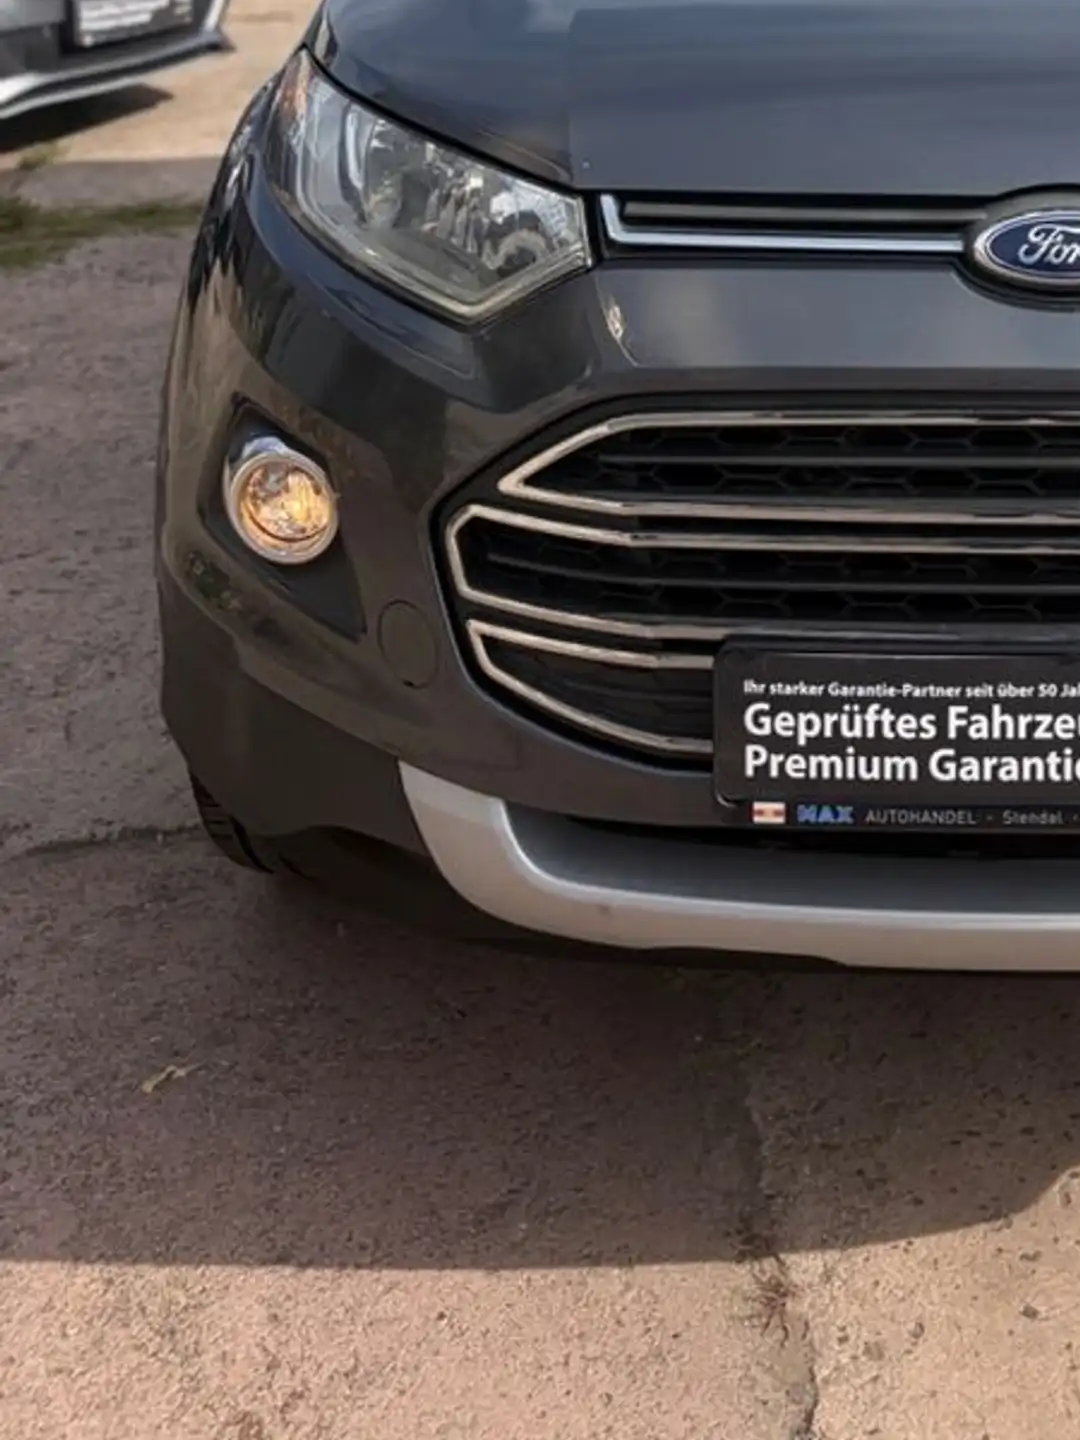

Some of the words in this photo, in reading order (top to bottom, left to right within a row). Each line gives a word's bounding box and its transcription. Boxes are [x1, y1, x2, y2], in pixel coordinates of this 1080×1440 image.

[743, 679, 765, 696] Ihr
[769, 681, 825, 697] starker
[827, 681, 962, 698] Garantie-Partner
[965, 682, 995, 698] seit
[997, 682, 1035, 698] über
[1037, 683, 1058, 698] 50
[744, 702, 938, 746] Geprüftes
[744, 744, 920, 781] Premium
[797, 804, 853, 824] MAX
[864, 808, 976, 825] AUTOHANDEL
